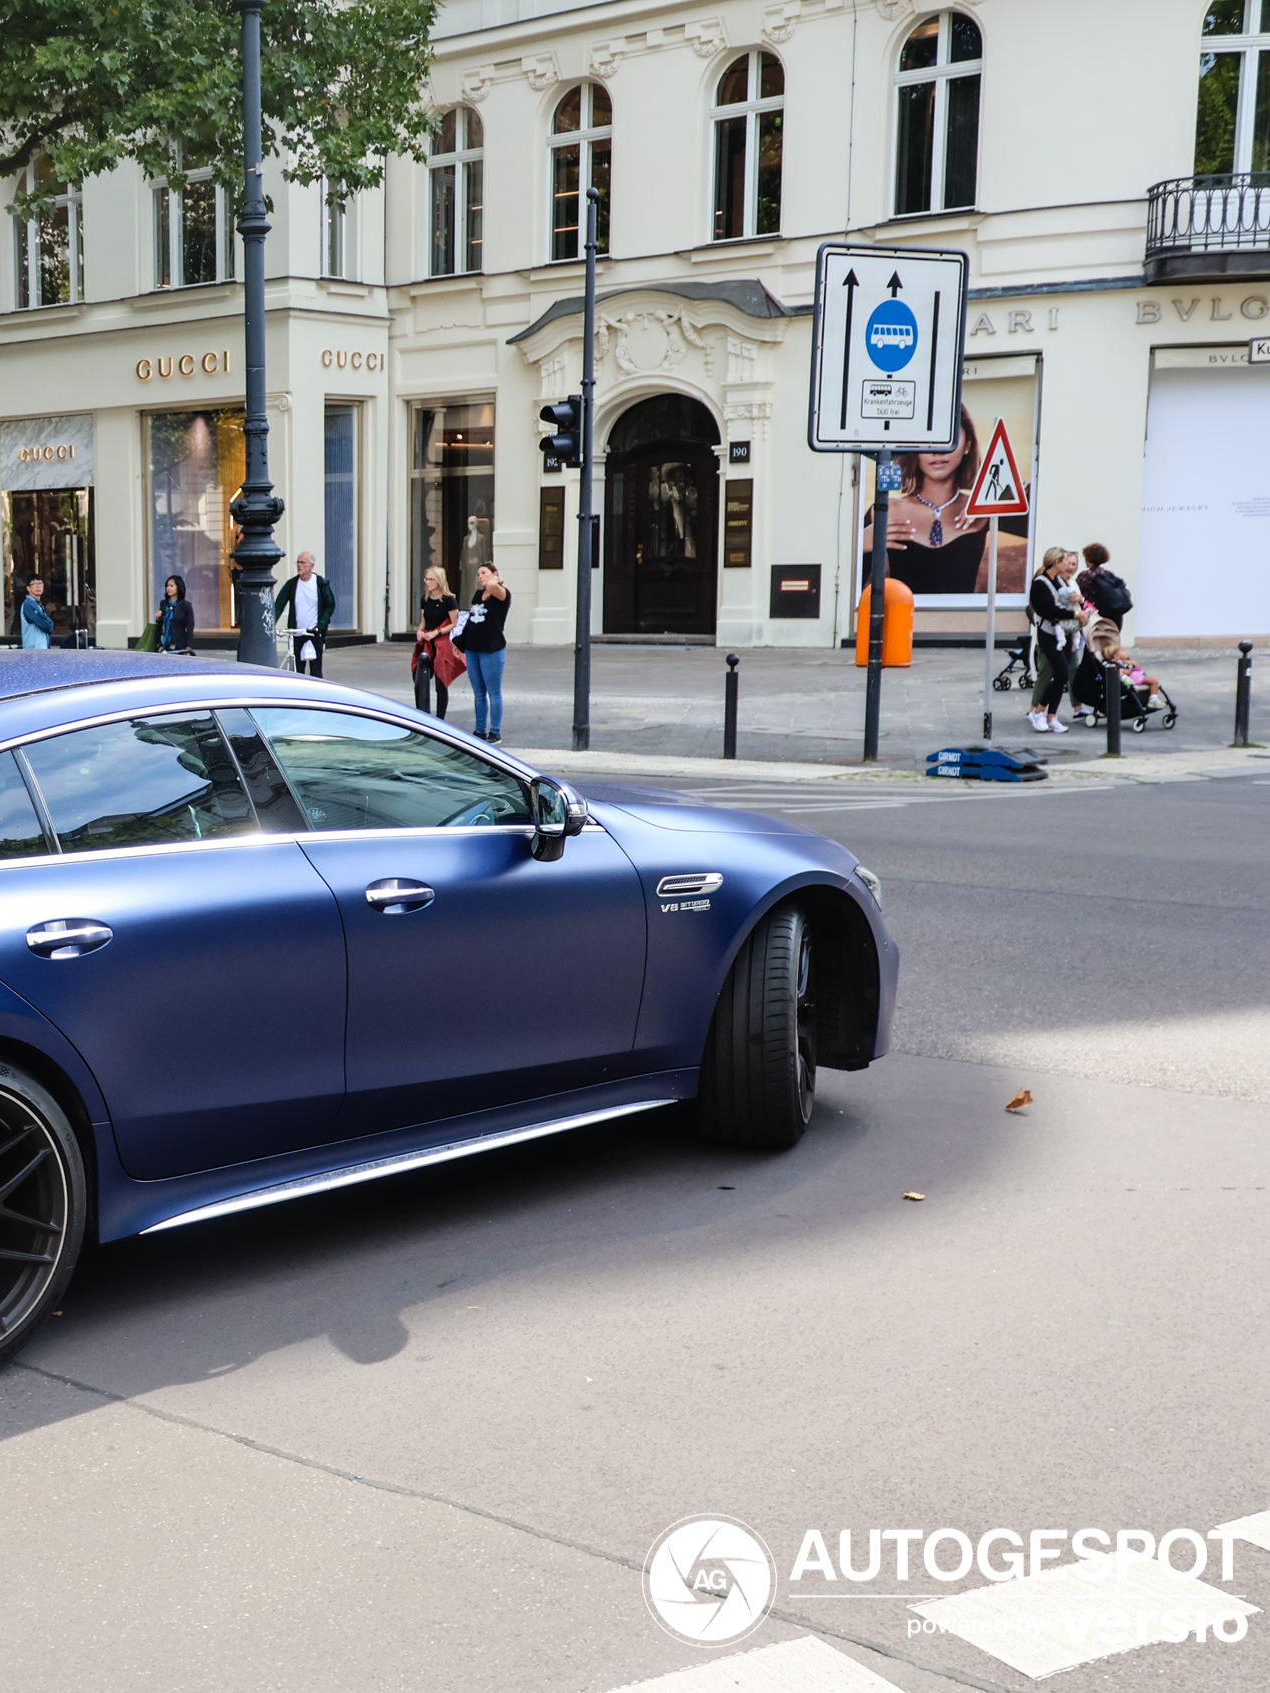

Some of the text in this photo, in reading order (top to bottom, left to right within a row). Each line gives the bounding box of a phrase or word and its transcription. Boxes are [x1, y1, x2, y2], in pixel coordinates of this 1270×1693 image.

[136, 350, 230, 381] GUCCI
[321, 349, 385, 372] GUCCI
[863, 398, 913, 407] Krankenfahrzeuge
[19, 444, 75, 463] GUCCI
[732, 447, 747, 457] 190
[660, 903, 679, 913] V8
